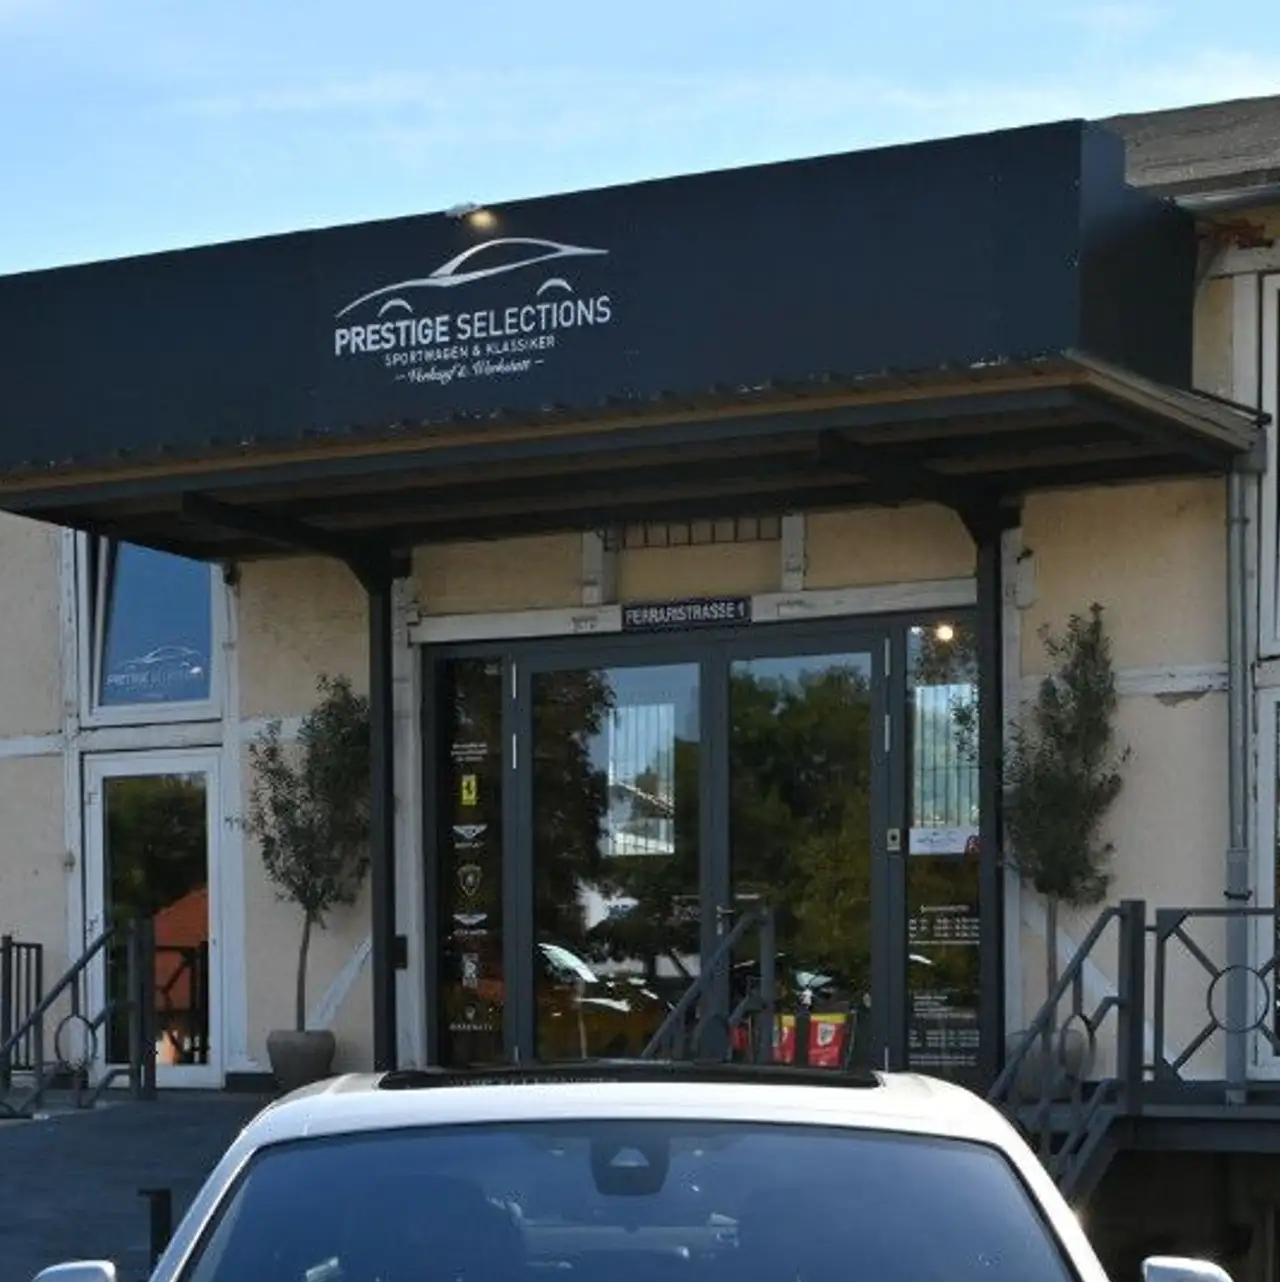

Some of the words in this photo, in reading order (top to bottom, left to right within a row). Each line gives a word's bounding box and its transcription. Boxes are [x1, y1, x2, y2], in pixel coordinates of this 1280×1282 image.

[335, 315, 450, 356] PRESTIGE
[457, 295, 612, 341] SELECTIONS
[385, 346, 469, 367] SPORTWAGEN
[471, 345, 481, 357] &
[486, 335, 556, 355] KLASSIKER
[626, 602, 735, 624] FERRARISTRASSE
